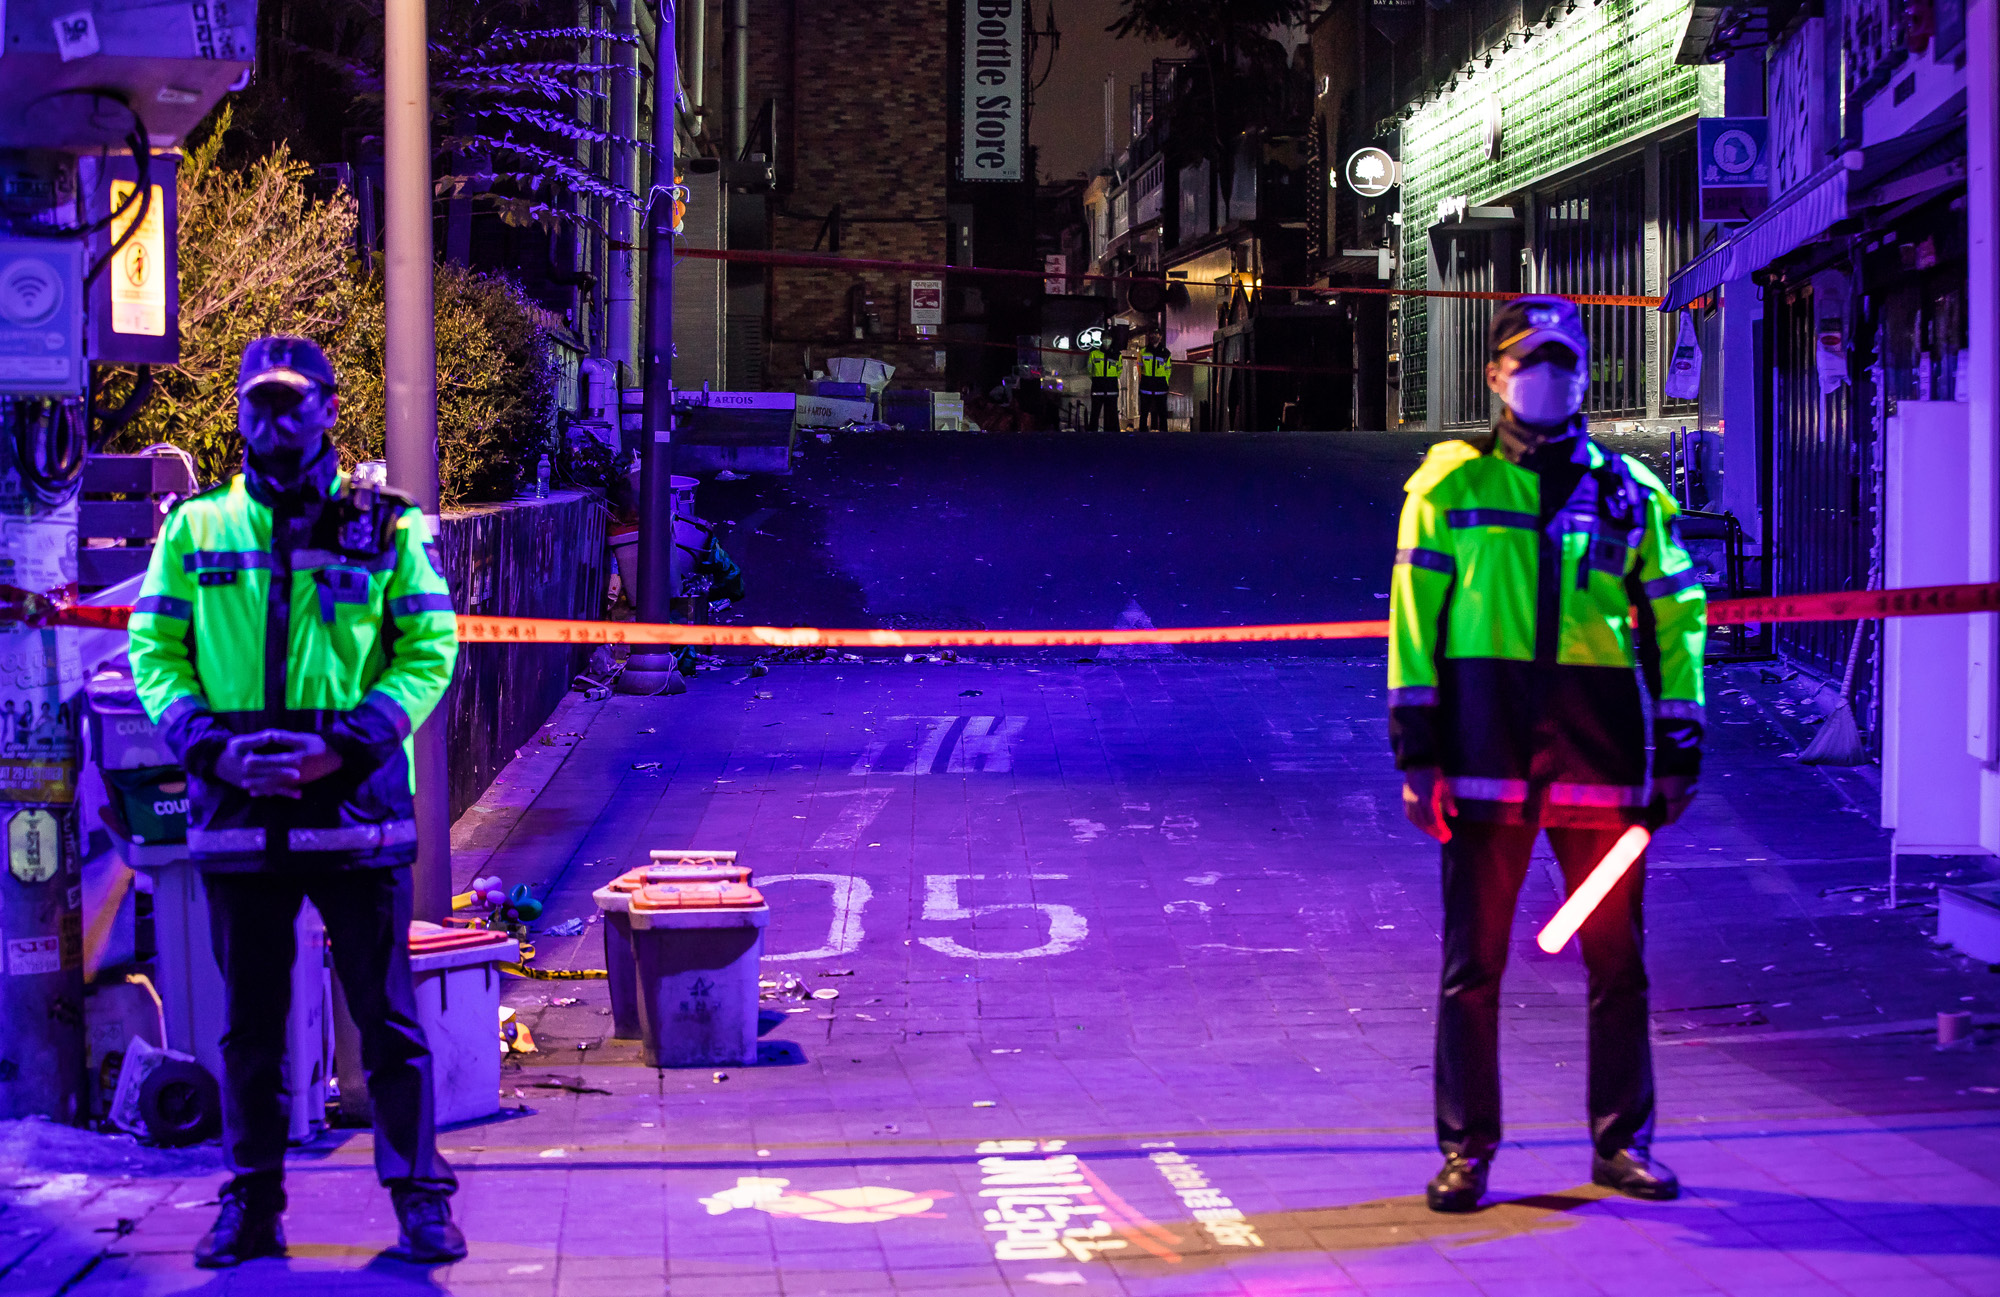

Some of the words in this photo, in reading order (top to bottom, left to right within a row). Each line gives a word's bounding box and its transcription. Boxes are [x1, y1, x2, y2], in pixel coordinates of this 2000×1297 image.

[976, 0, 1012, 86] Bottle
[975, 96, 1011, 169] Store
[714, 396, 754, 405] ARTOIS
[811, 406, 832, 417] ARTOIS
